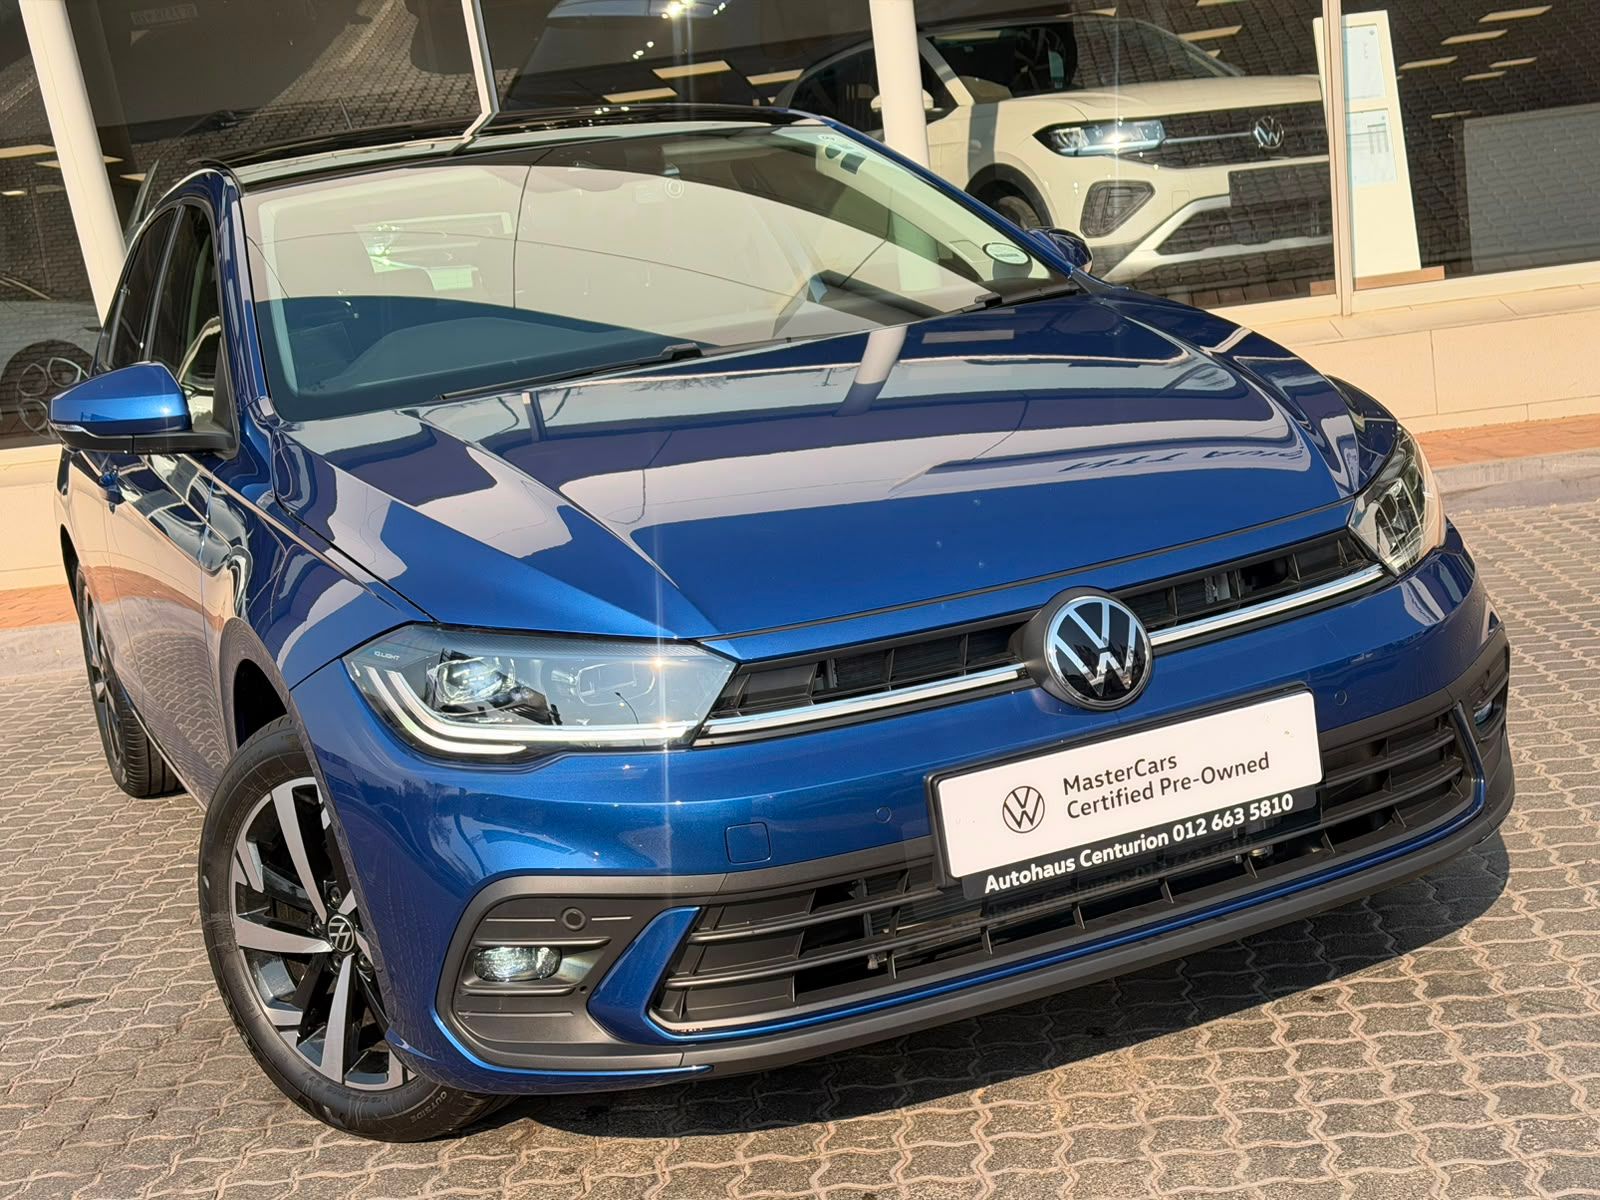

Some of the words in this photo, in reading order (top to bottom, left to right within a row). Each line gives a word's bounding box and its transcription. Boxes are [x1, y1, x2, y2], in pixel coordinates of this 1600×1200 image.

[1045, 596, 1151, 703] VW
[1062, 754, 1178, 796] MasterCars
[1066, 782, 1155, 820] Certified
[1159, 752, 1271, 799] Pre-Owned
[1002, 785, 1045, 834] VW
[984, 856, 1076, 894] Autohaus
[1079, 831, 1169, 868] Centurion
[1172, 817, 1207, 843] 012
[1211, 806, 1246, 832] 663
[1249, 793, 1294, 820] 5810
[328, 915, 354, 952] VW
